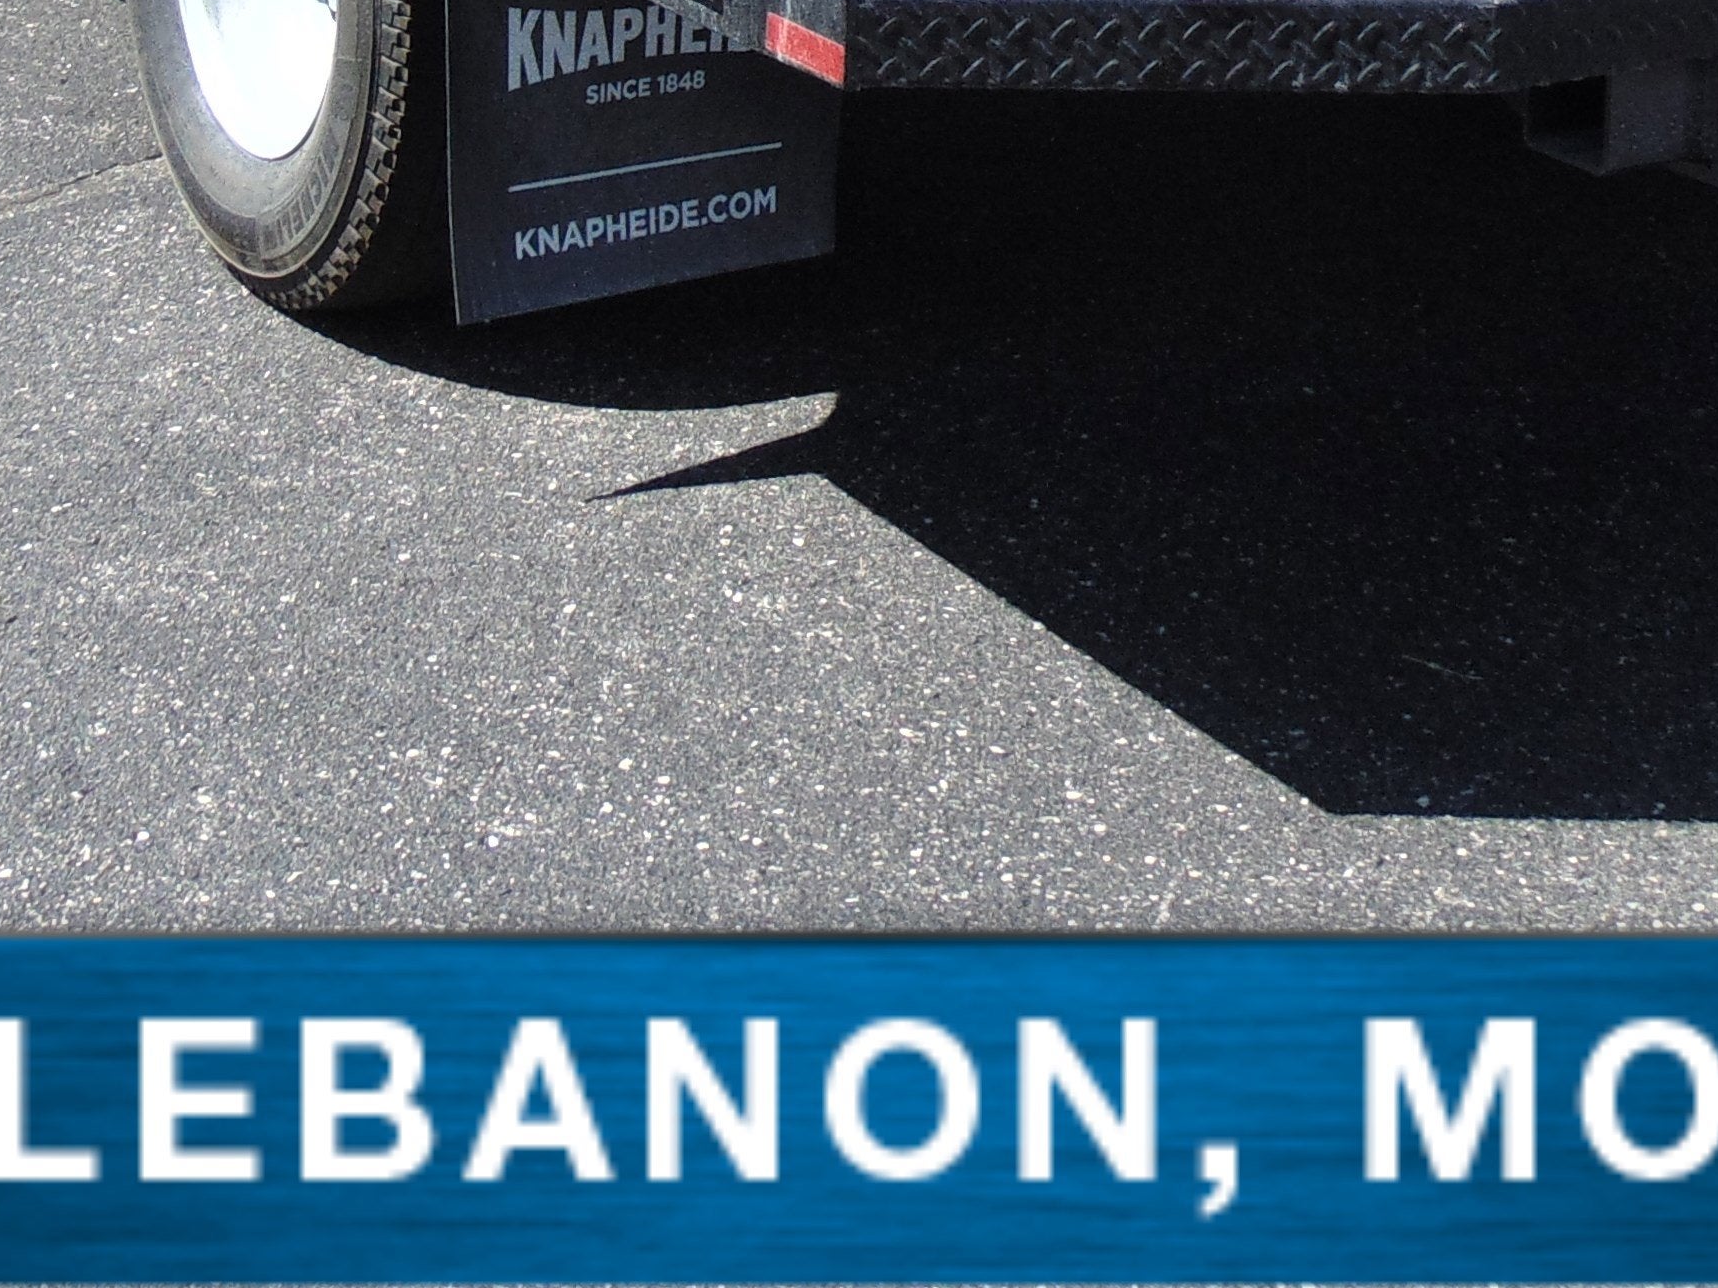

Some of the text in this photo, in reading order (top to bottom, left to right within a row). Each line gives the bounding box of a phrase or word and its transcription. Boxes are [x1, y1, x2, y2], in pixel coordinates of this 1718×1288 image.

[506, 4, 749, 92] KNAPHE
[586, 69, 706, 105] SINCE 1848
[514, 185, 777, 260] KNAPHEIDE.COM
